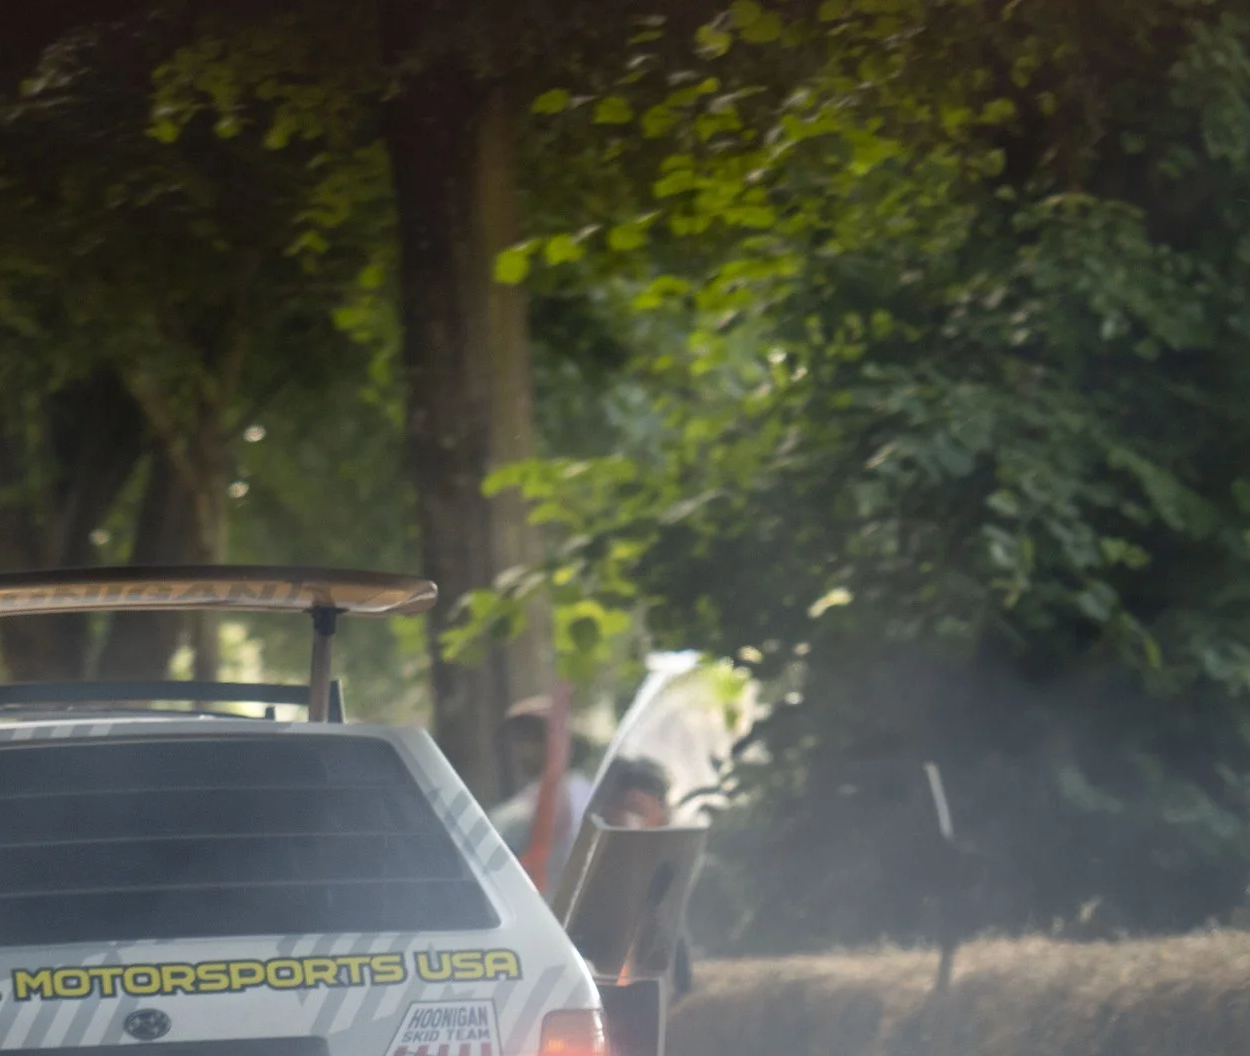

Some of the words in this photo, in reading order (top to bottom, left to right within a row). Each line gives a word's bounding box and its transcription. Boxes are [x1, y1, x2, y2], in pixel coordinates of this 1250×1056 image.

[12, 952, 407, 1001] MOTORSPORTS
[415, 947, 522, 983] USA
[407, 1006, 488, 1029] HOONIGAN
[401, 1030, 440, 1043] SKID
[445, 1028, 491, 1042] TEAM
